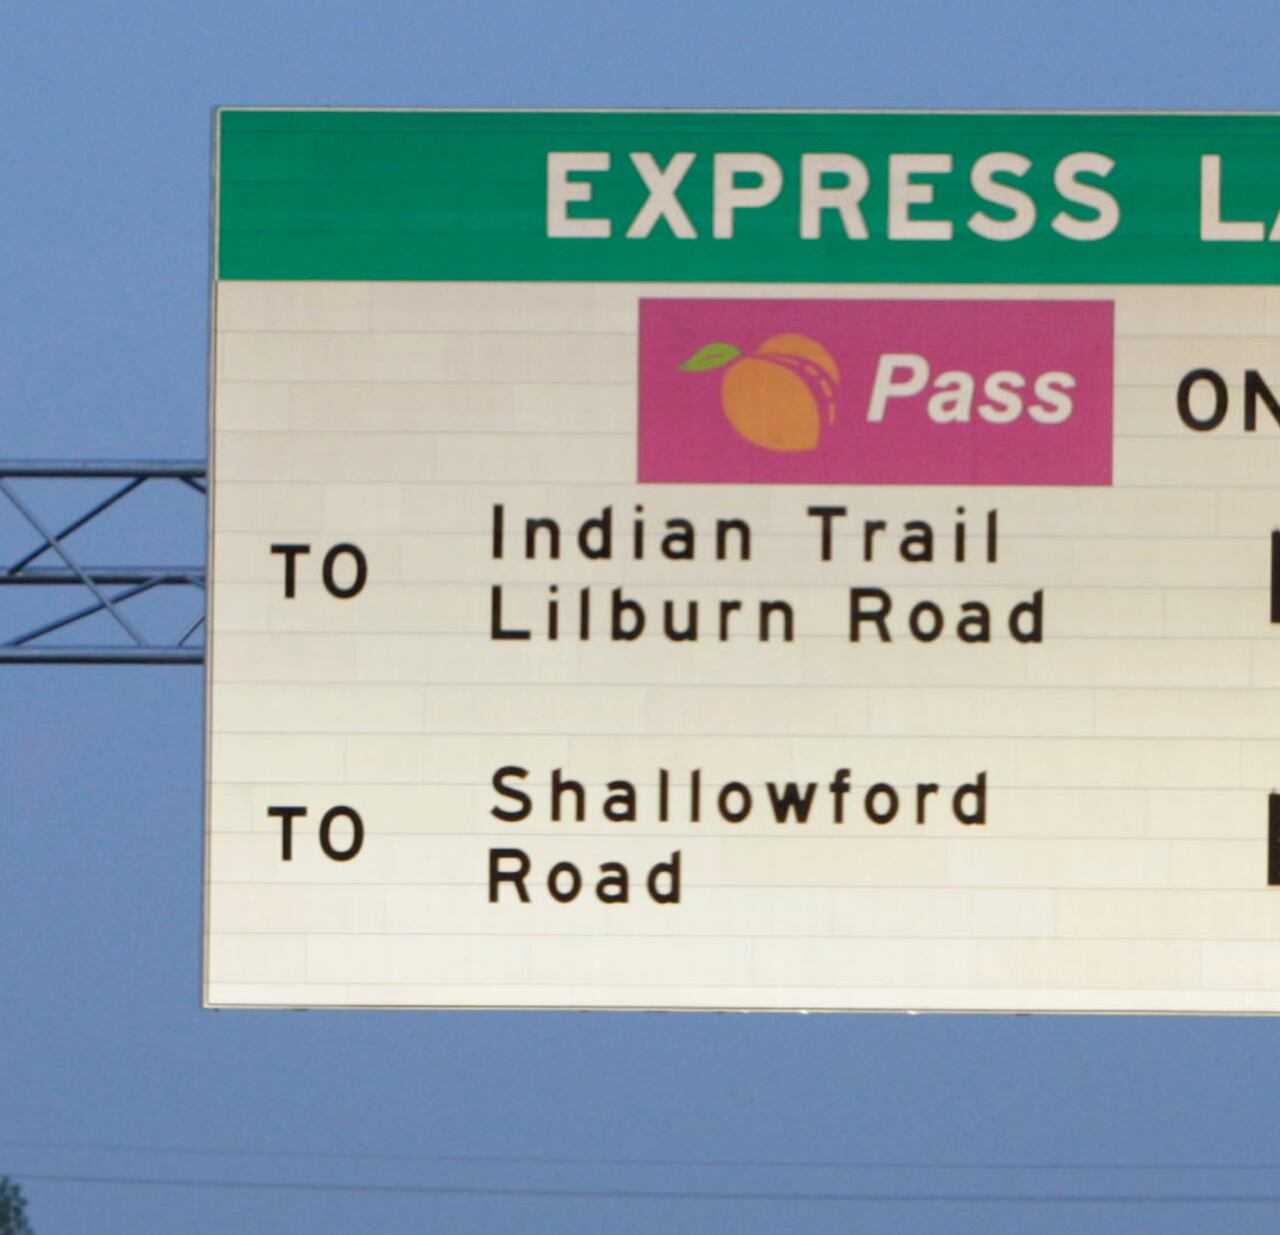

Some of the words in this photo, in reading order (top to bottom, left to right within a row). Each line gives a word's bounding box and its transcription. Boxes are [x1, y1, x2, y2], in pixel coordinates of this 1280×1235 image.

[547, 152, 1119, 241] EXPRESS
[867, 353, 1076, 424] Pass
[492, 504, 751, 561] Indian
[808, 507, 997, 563] Trail
[271, 543, 368, 599] TO
[491, 585, 793, 642] Lilburn
[850, 588, 1043, 644] Road
[491, 766, 986, 825] Shallowford
[268, 805, 364, 862] TO
[490, 848, 680, 904] Road
